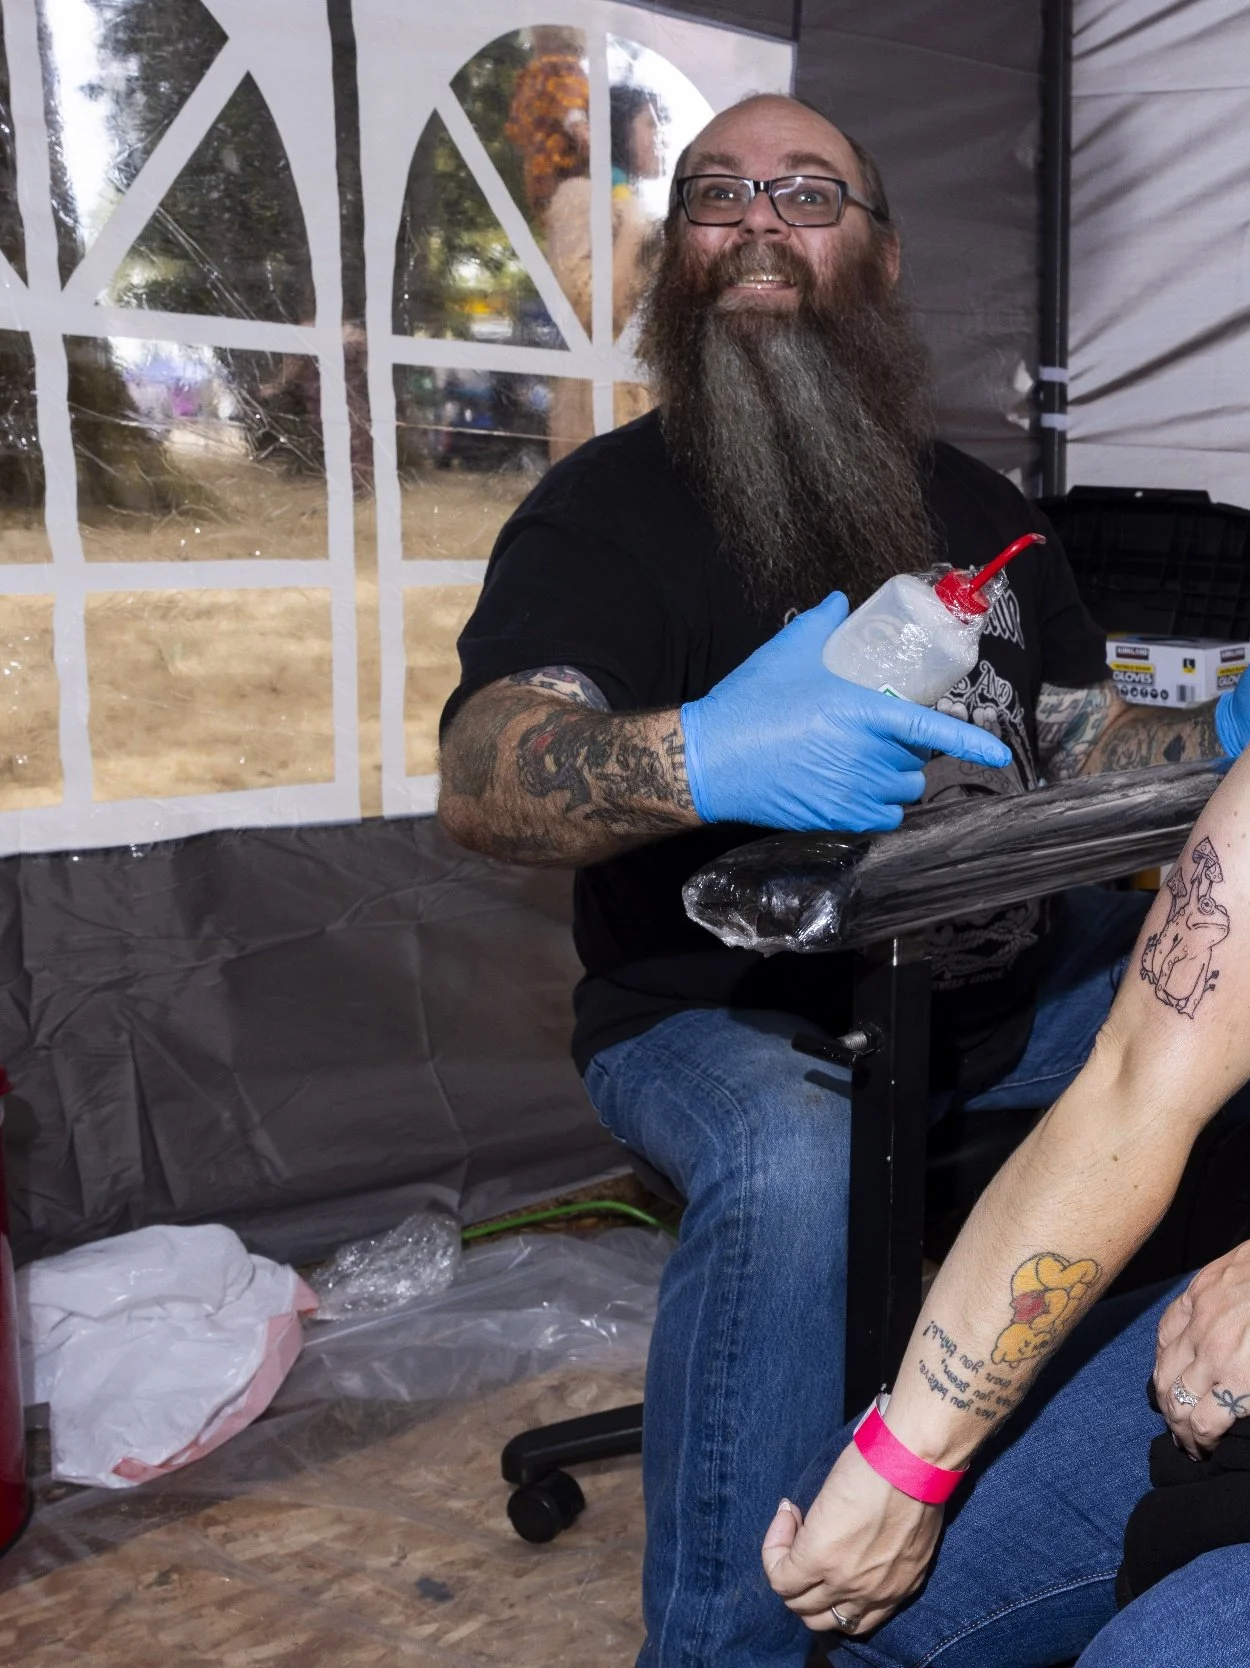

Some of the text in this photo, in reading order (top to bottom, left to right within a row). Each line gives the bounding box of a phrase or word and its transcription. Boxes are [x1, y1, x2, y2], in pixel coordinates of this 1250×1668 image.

[1113, 671, 1152, 684] GLOVES
[959, 1354, 985, 1375] you
[950, 1395, 975, 1411] you
